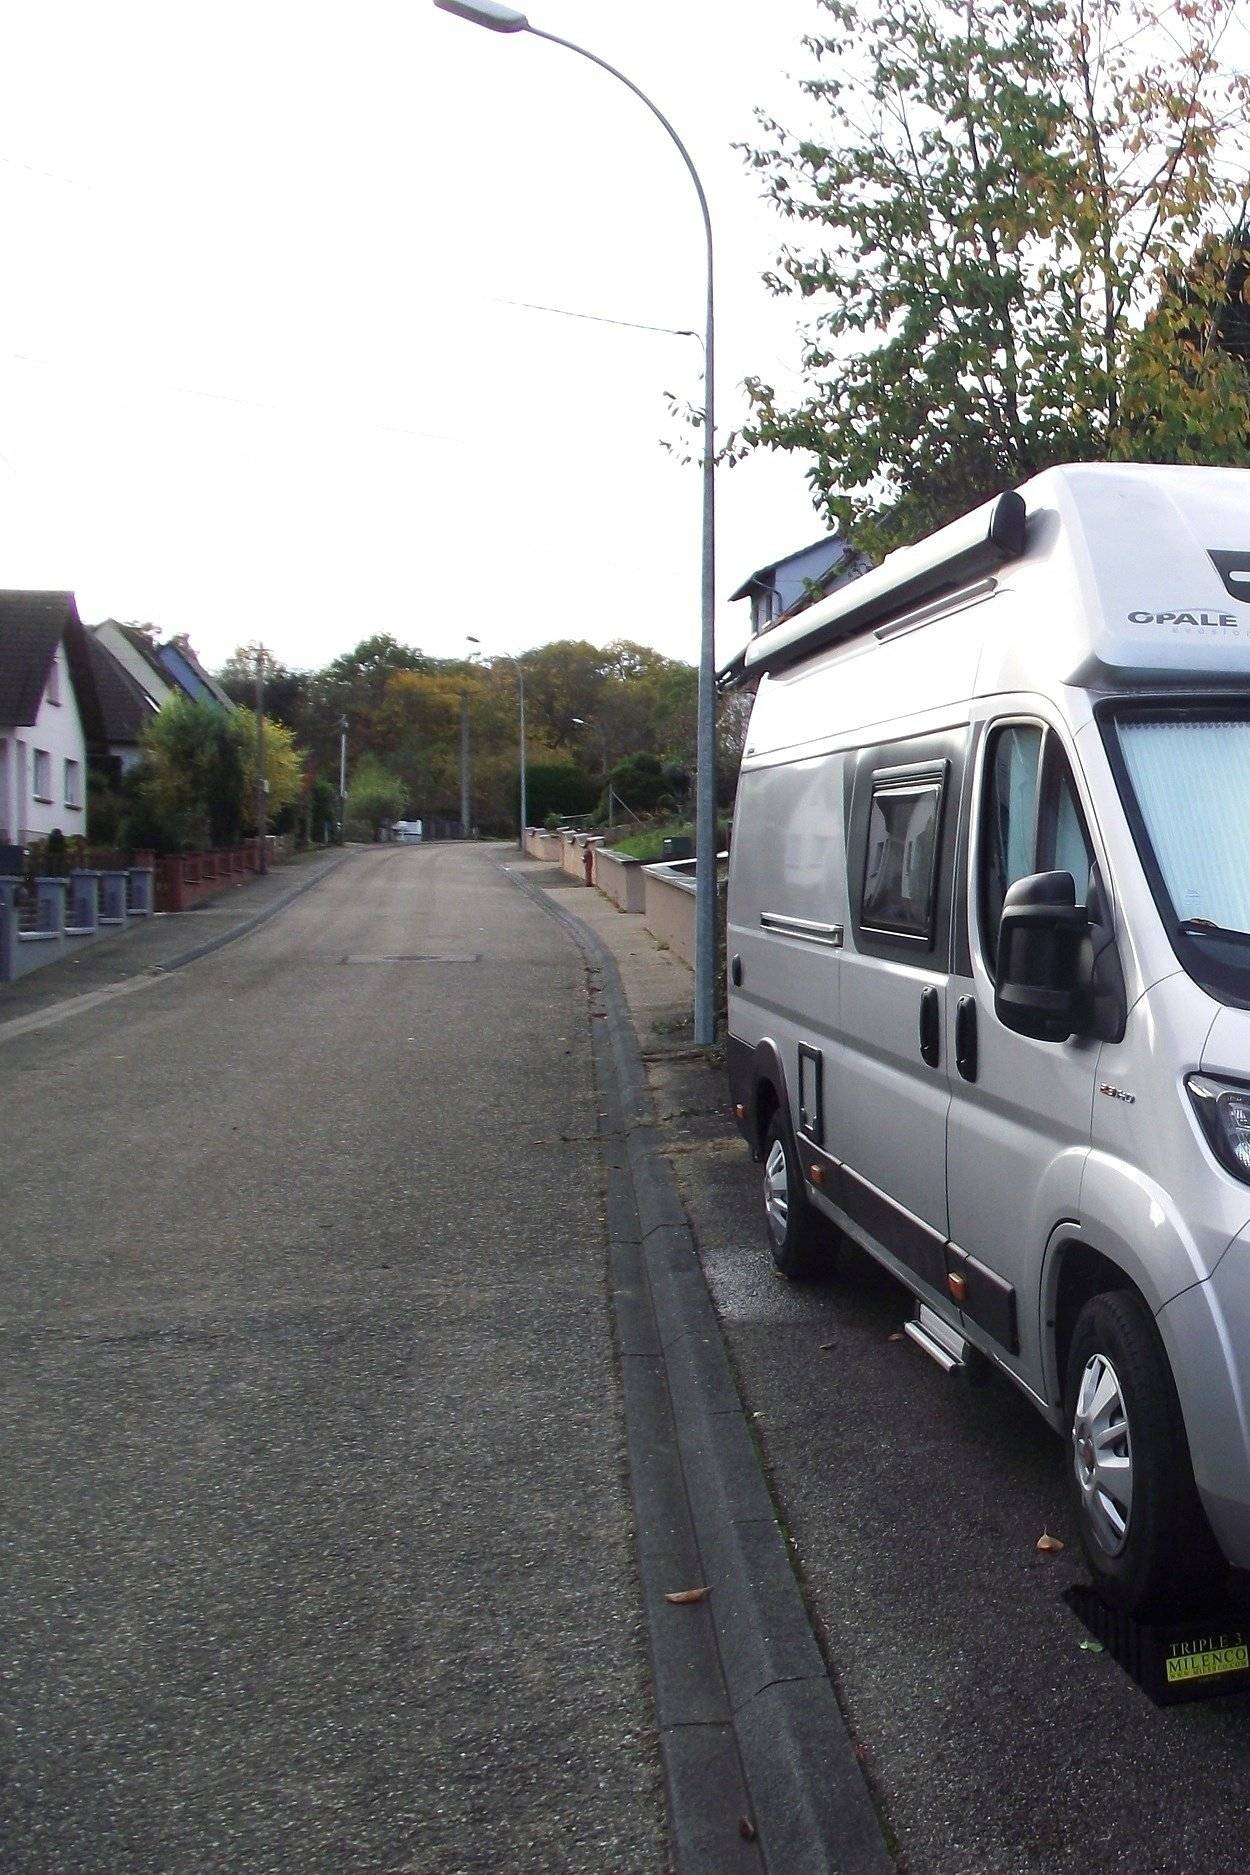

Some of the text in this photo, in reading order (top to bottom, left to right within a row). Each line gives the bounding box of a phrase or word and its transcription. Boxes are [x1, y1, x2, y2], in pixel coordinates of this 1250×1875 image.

[1127, 611, 1238, 627] OPALE
[1169, 1635, 1229, 1657] TRIPLE
[1169, 1648, 1247, 1673] MILENCO
